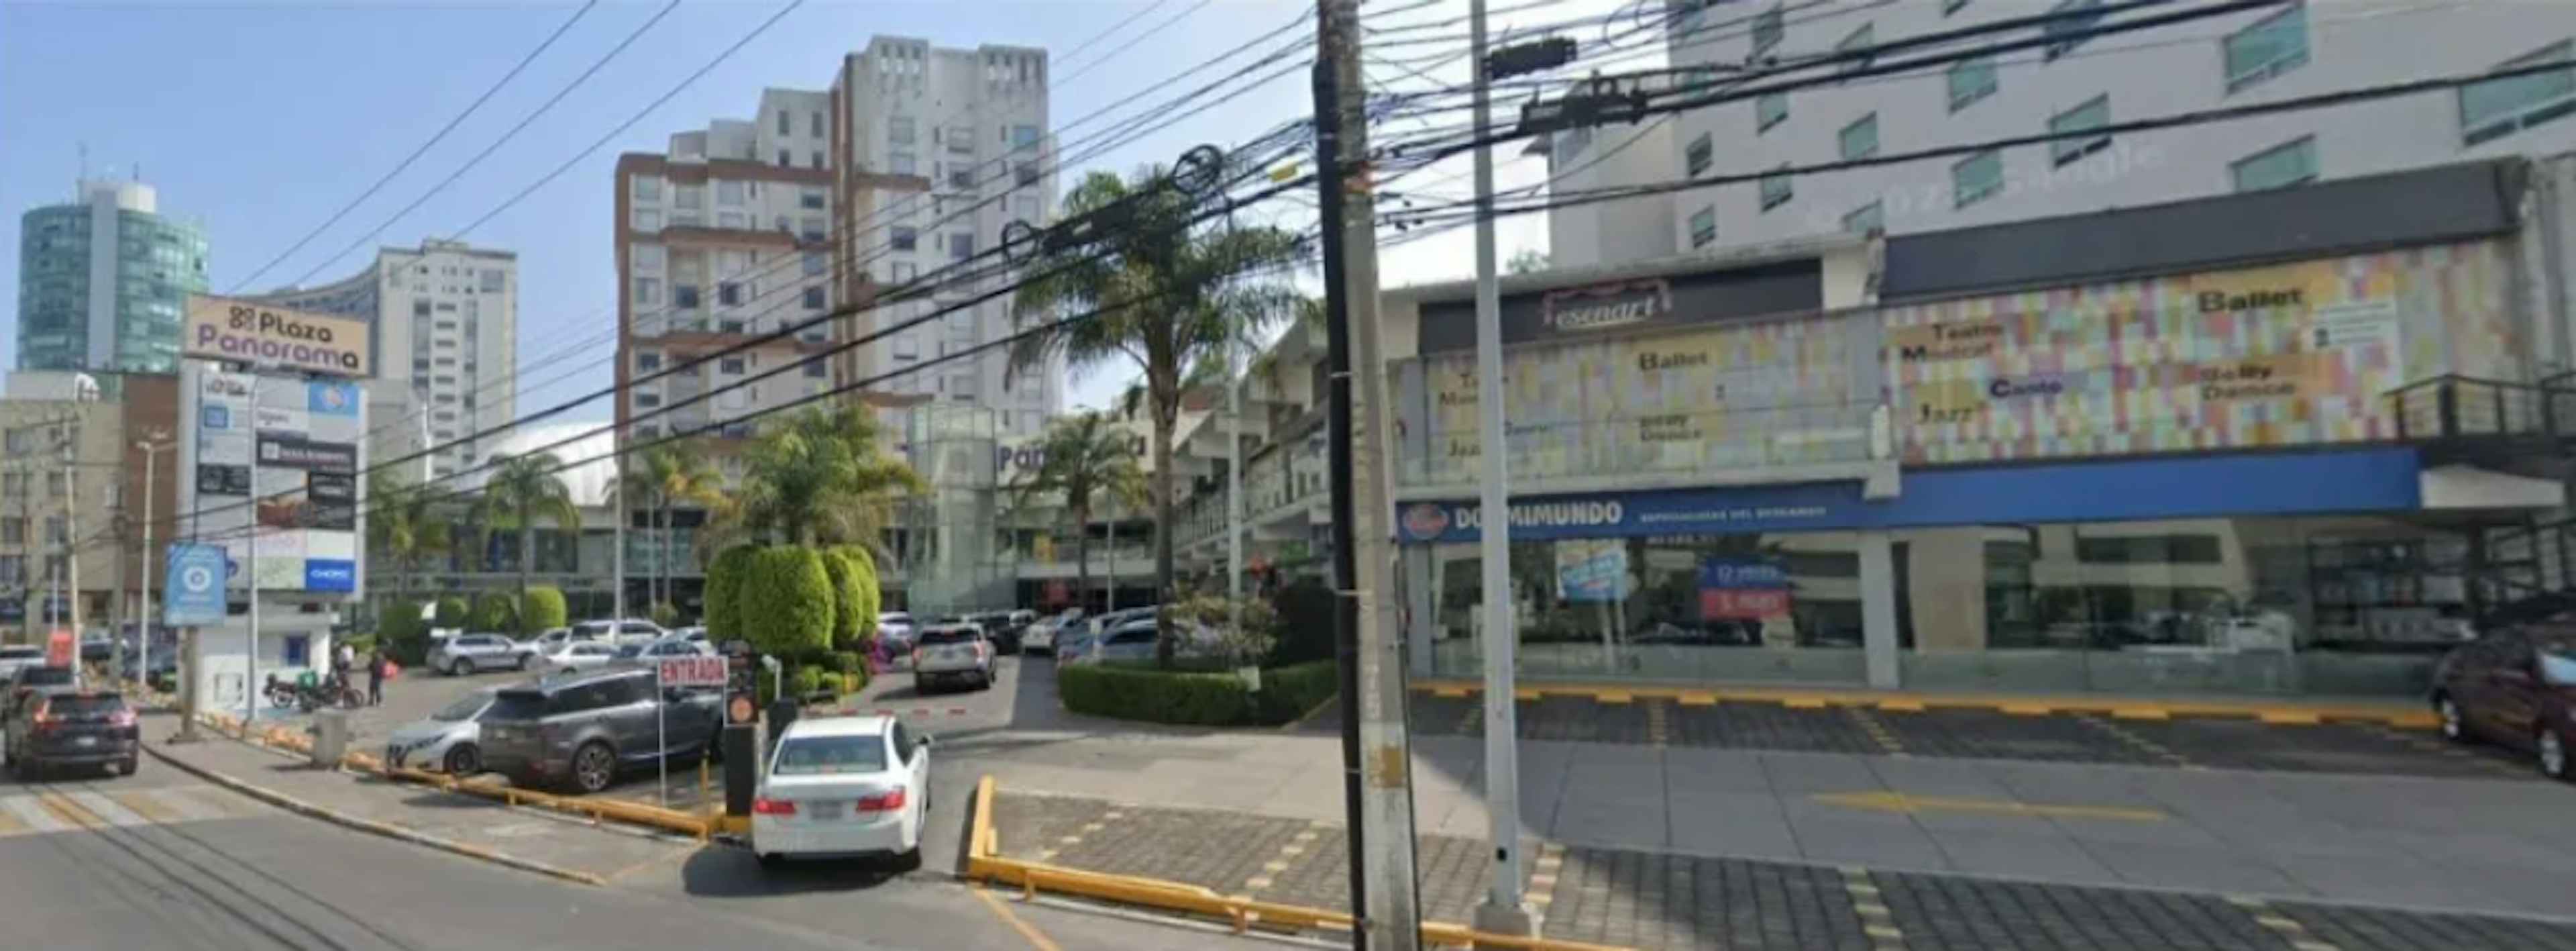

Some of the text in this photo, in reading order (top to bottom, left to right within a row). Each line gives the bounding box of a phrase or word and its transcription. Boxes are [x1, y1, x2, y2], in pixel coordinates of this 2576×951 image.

[2199, 288, 2302, 312] Ballet
[260, 312, 333, 343] Plaza
[197, 323, 360, 369] Panorama
[1455, 501, 1623, 529] DOMIMUNDO
[661, 658, 725, 682] ENTRADA
